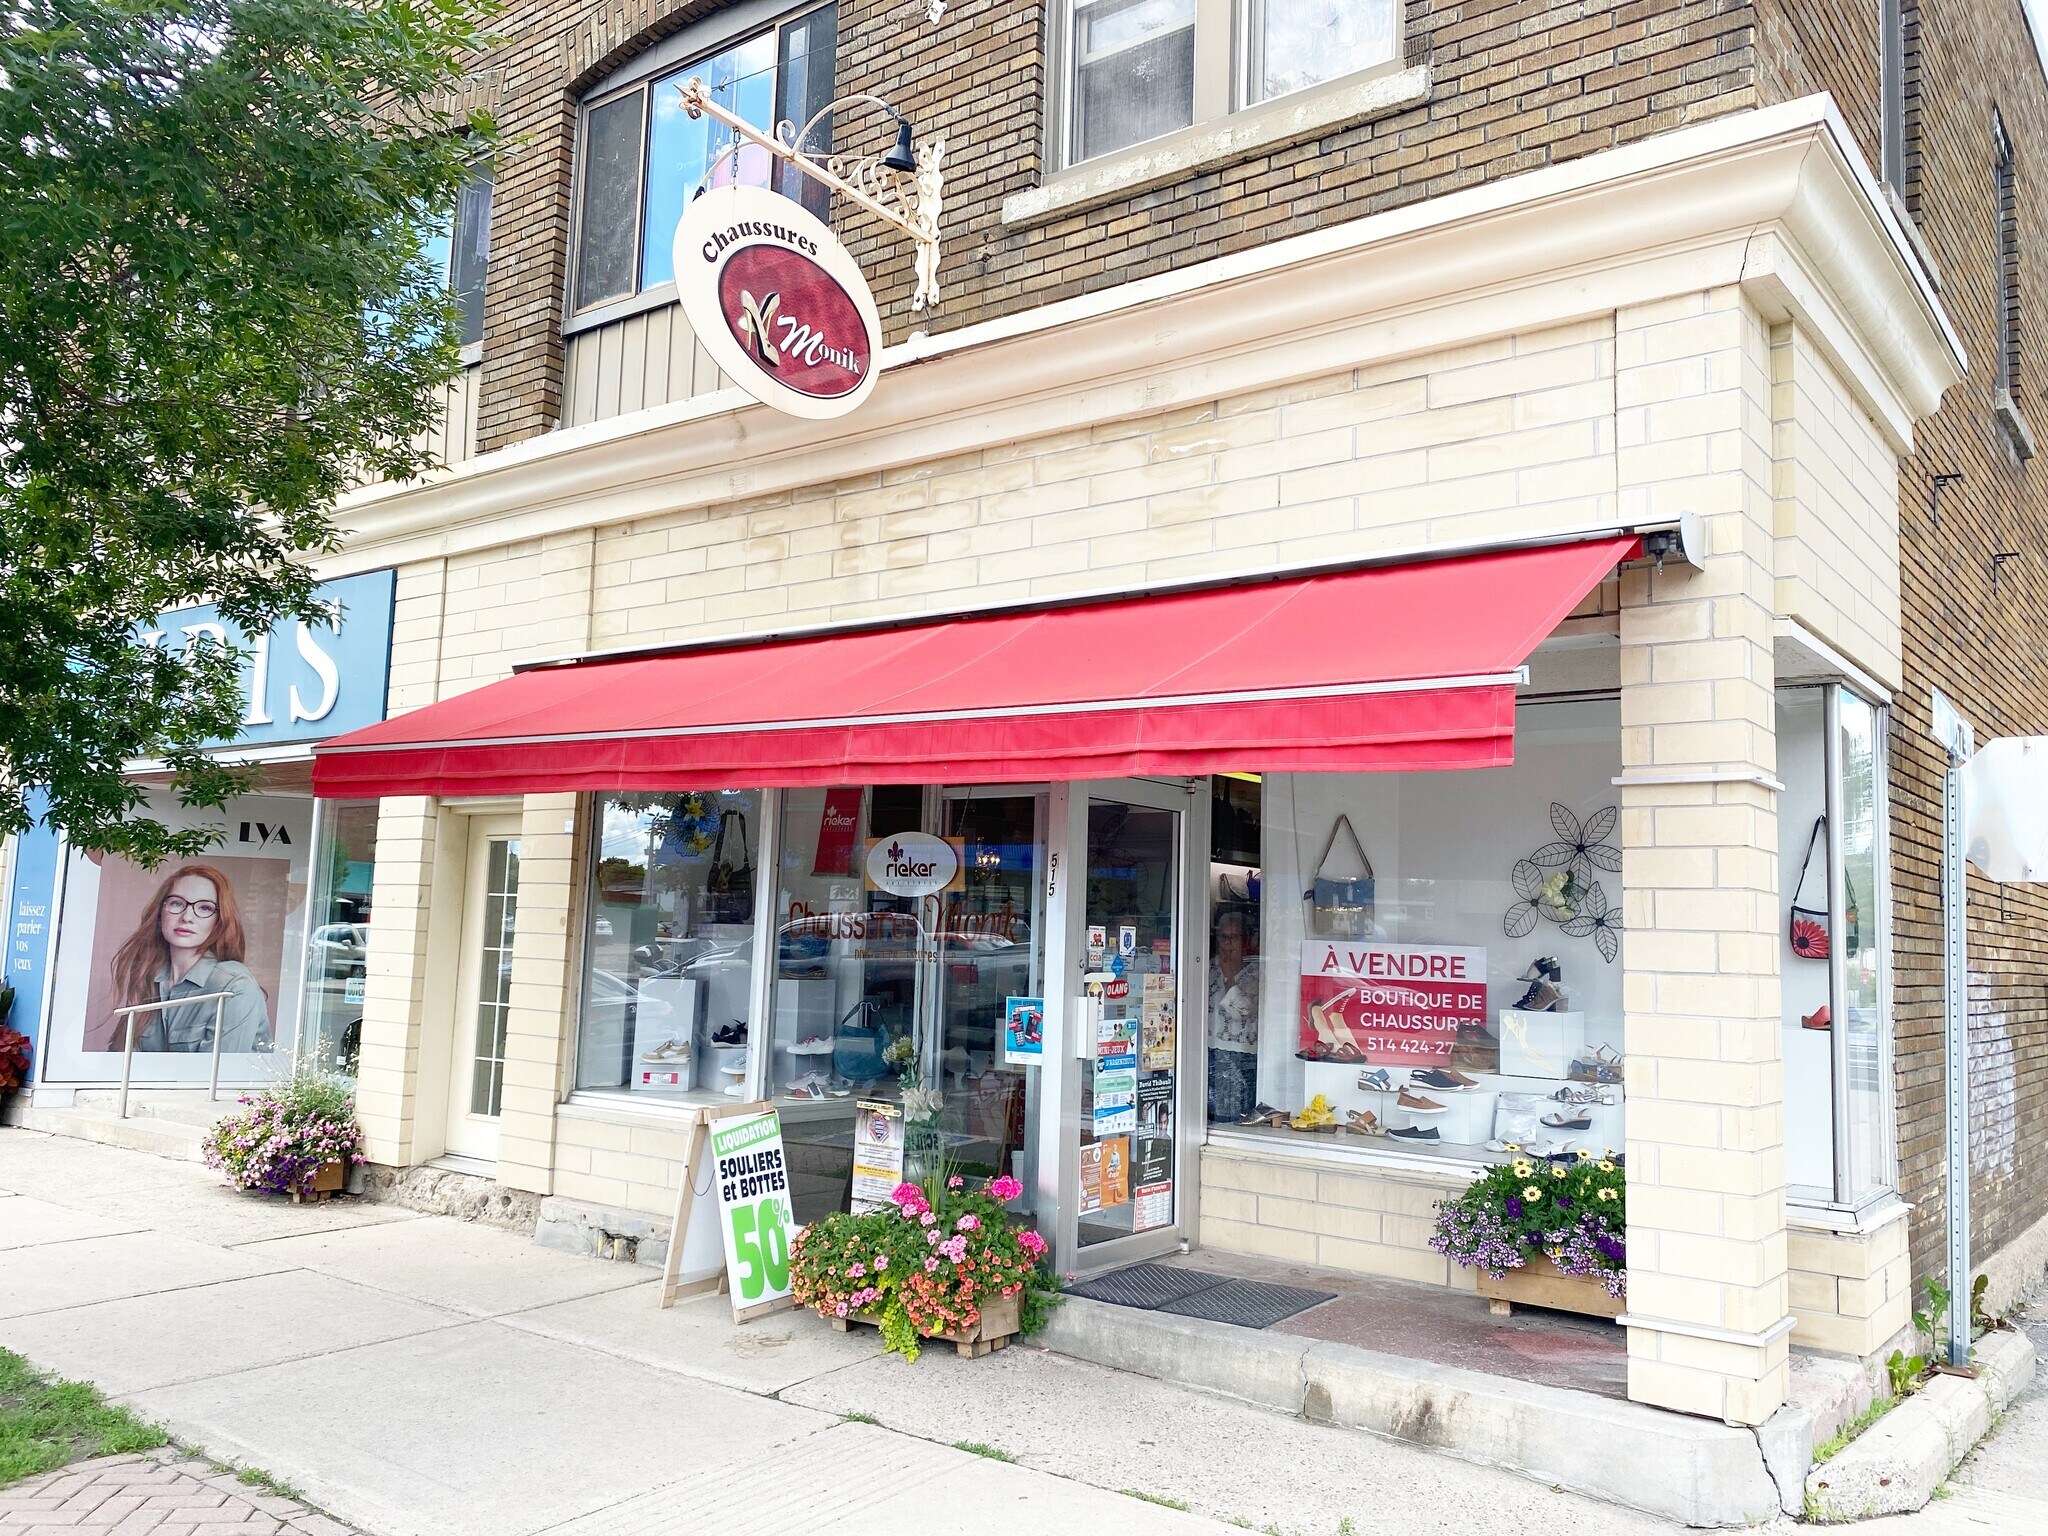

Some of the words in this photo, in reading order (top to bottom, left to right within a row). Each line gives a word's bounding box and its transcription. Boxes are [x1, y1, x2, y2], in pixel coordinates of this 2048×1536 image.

[702, 221, 818, 263] Chaussures
[776, 314, 861, 375] Monik
[823, 813, 856, 826] rieker
[239, 822, 292, 850] LYA
[886, 856, 937, 878] rieker
[18, 901, 46, 916] laissez
[789, 902, 919, 940] Chaussures
[925, 895, 1018, 943] Monik
[16, 919, 42, 937] parler
[15, 940, 29, 952] vos
[13, 958, 32, 972] yeux
[1321, 944, 1342, 973] À
[1348, 952, 1466, 979] VENDRE
[1107, 982, 1129, 995] OLANG
[1360, 990, 1453, 1010] BOUTIQUE
[1458, 994, 1482, 1010] DE
[1367, 1037, 1396, 1051] 514
[1400, 1039, 1455, 1055] 424-27
[716, 1118, 777, 1152] LIQUIDATION
[719, 1149, 782, 1179] SOULIERS
[723, 1184, 738, 1202] et
[740, 1171, 785, 1199] BOTTES
